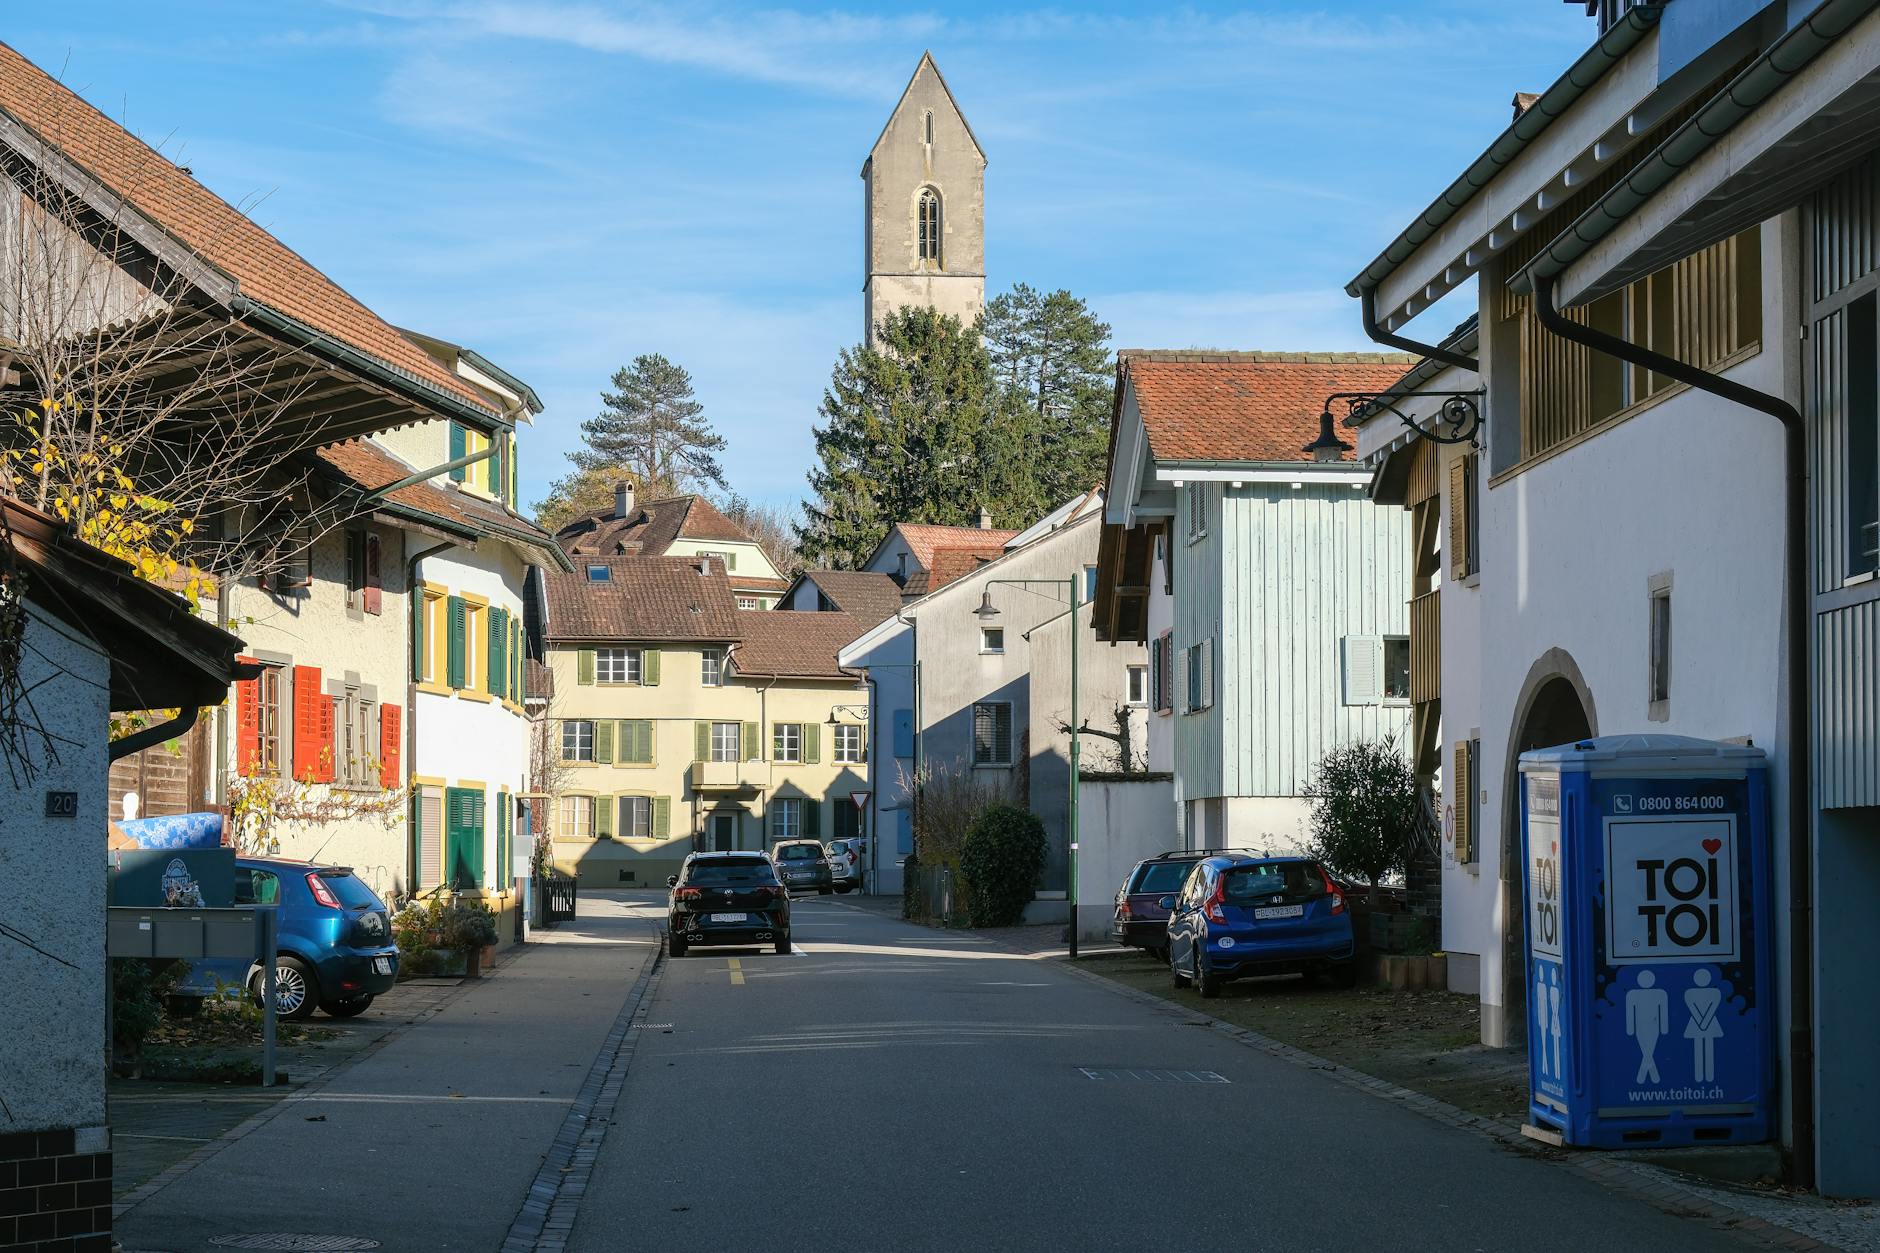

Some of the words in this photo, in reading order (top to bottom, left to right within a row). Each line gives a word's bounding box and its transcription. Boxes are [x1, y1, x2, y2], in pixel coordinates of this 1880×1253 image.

[54, 796, 72, 812] 20
[1640, 797, 1671, 810] 0800
[1675, 797, 1698, 810] 864
[1701, 796, 1724, 809] 000
[1537, 858, 1556, 901] TOI
[1637, 858, 1718, 901] TOI
[1538, 902, 1557, 946] TOI
[1638, 904, 1719, 947] TOI
[1628, 1085, 1724, 1101] www.toitoi.ch
